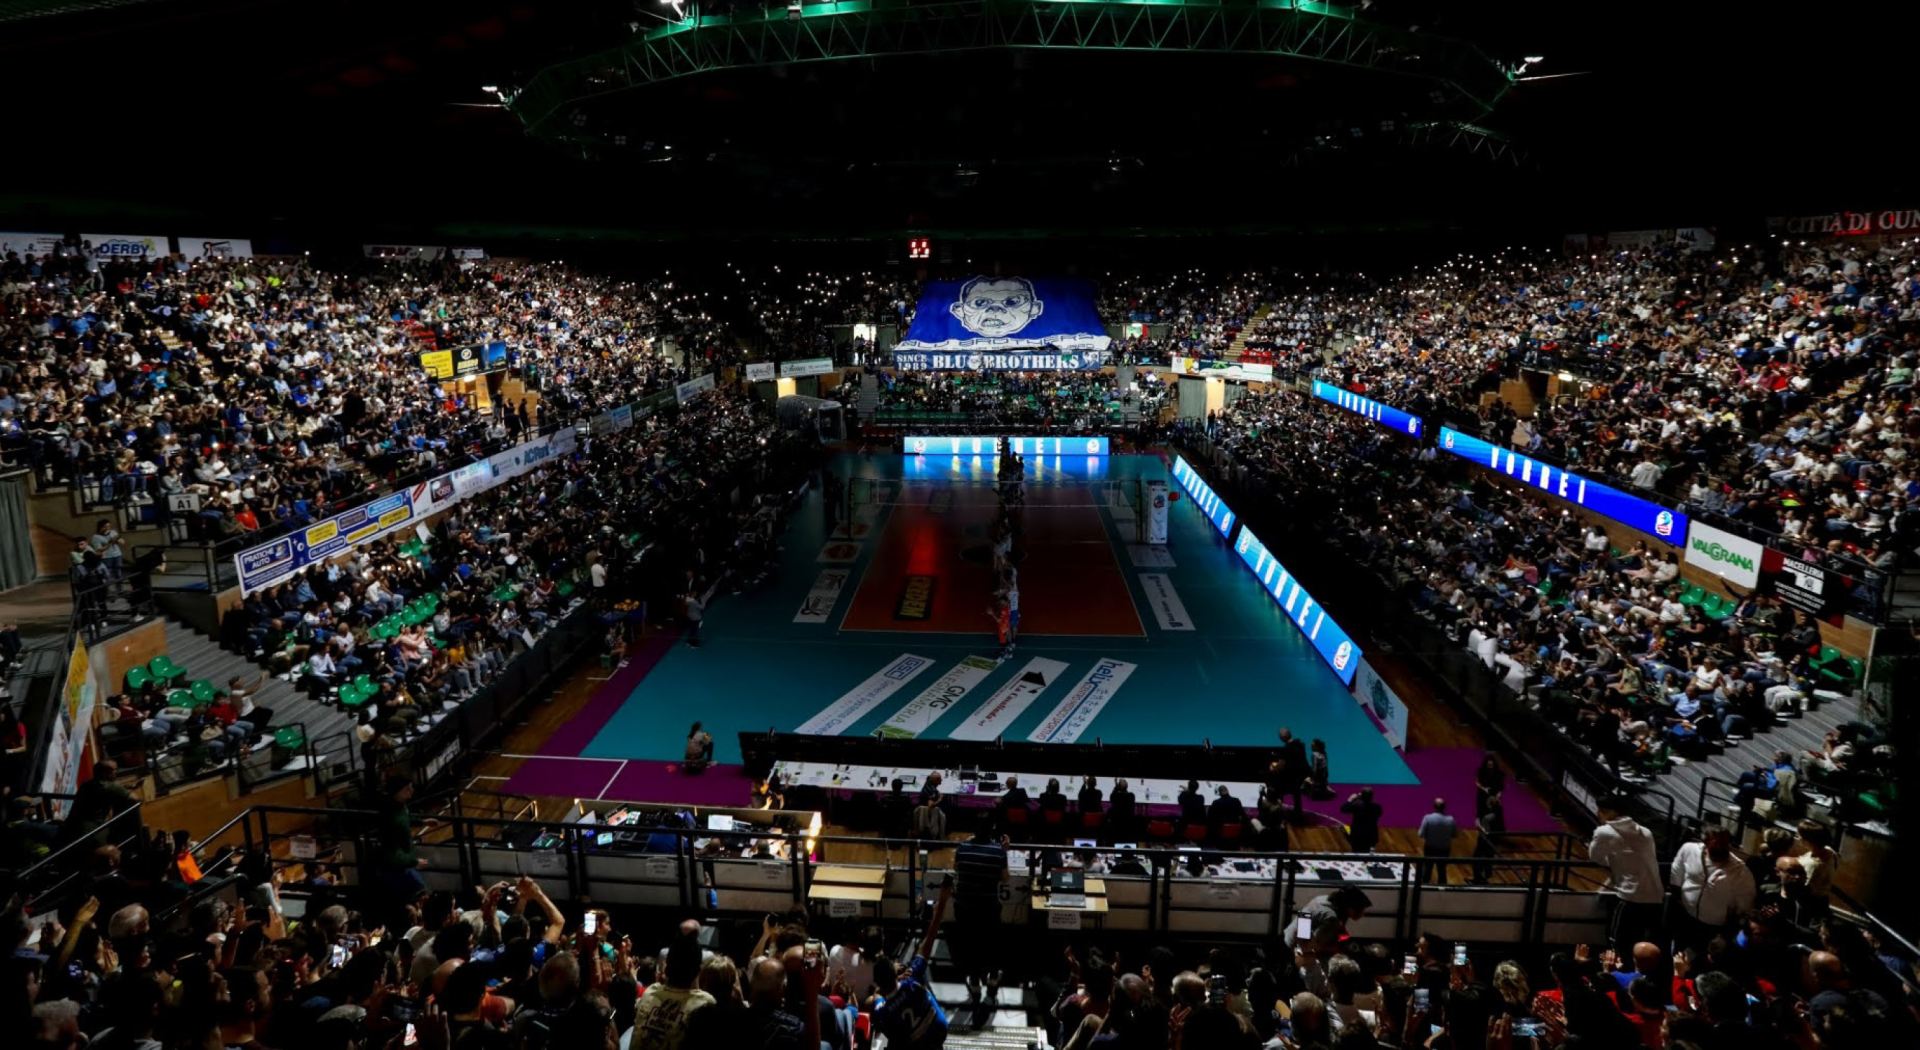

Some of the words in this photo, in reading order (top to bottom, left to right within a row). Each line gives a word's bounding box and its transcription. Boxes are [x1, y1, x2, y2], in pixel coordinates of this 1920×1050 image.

[1848, 212, 1872, 231] DI
[99, 242, 149, 255] DERBY
[896, 354, 927, 363] SINCE
[897, 362, 927, 371] 1989
[932, 354, 966, 369] BLU
[178, 499, 191, 509] A1
[244, 547, 274, 564] PRATICHE
[252, 557, 271, 569] AUTO
[1691, 536, 1754, 573] VALGRANA
[891, 659, 921, 678] GSC
[1085, 661, 1124, 687] helix
[895, 666, 970, 723] FALEGNAMERIA
[929, 686, 965, 710] GMG
